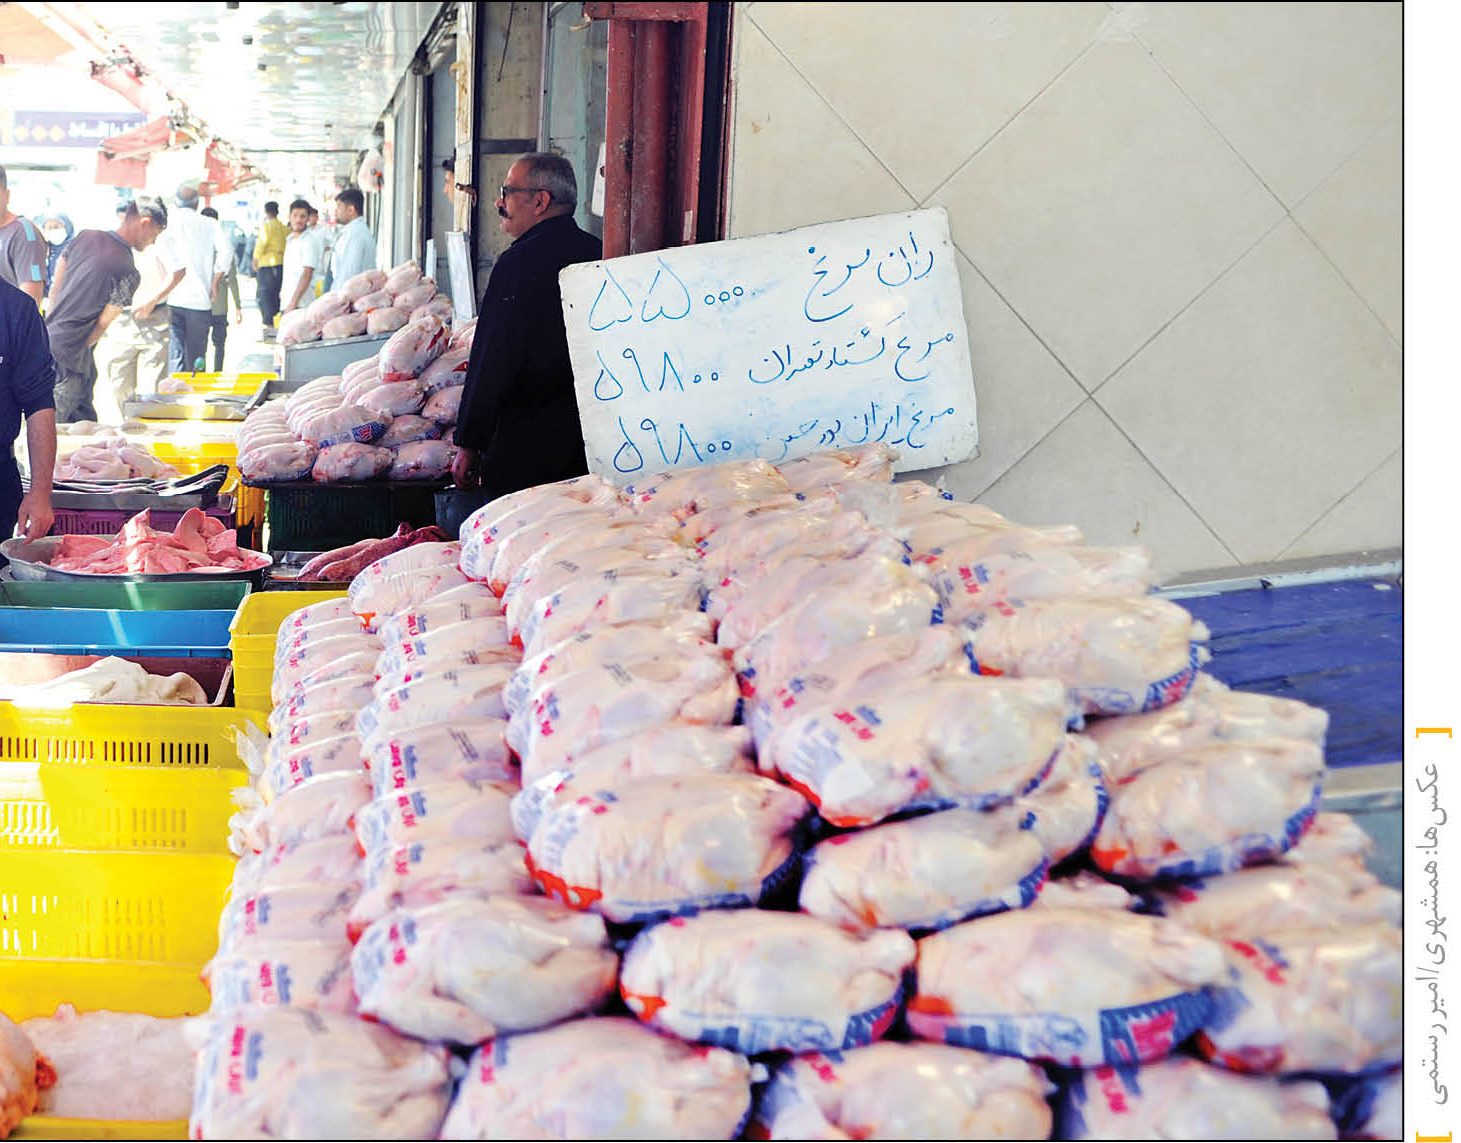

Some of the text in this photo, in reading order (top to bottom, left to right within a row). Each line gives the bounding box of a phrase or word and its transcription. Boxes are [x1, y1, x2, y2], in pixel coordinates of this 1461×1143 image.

[804, 246, 871, 323] مرغ
[594, 348, 719, 401] ۵۹۸۰۰
[748, 340, 823, 384] تهران
[613, 416, 732, 473] ۵۹۸۰۰
[844, 401, 905, 445] ایران
[906, 402, 955, 449] مرغ
